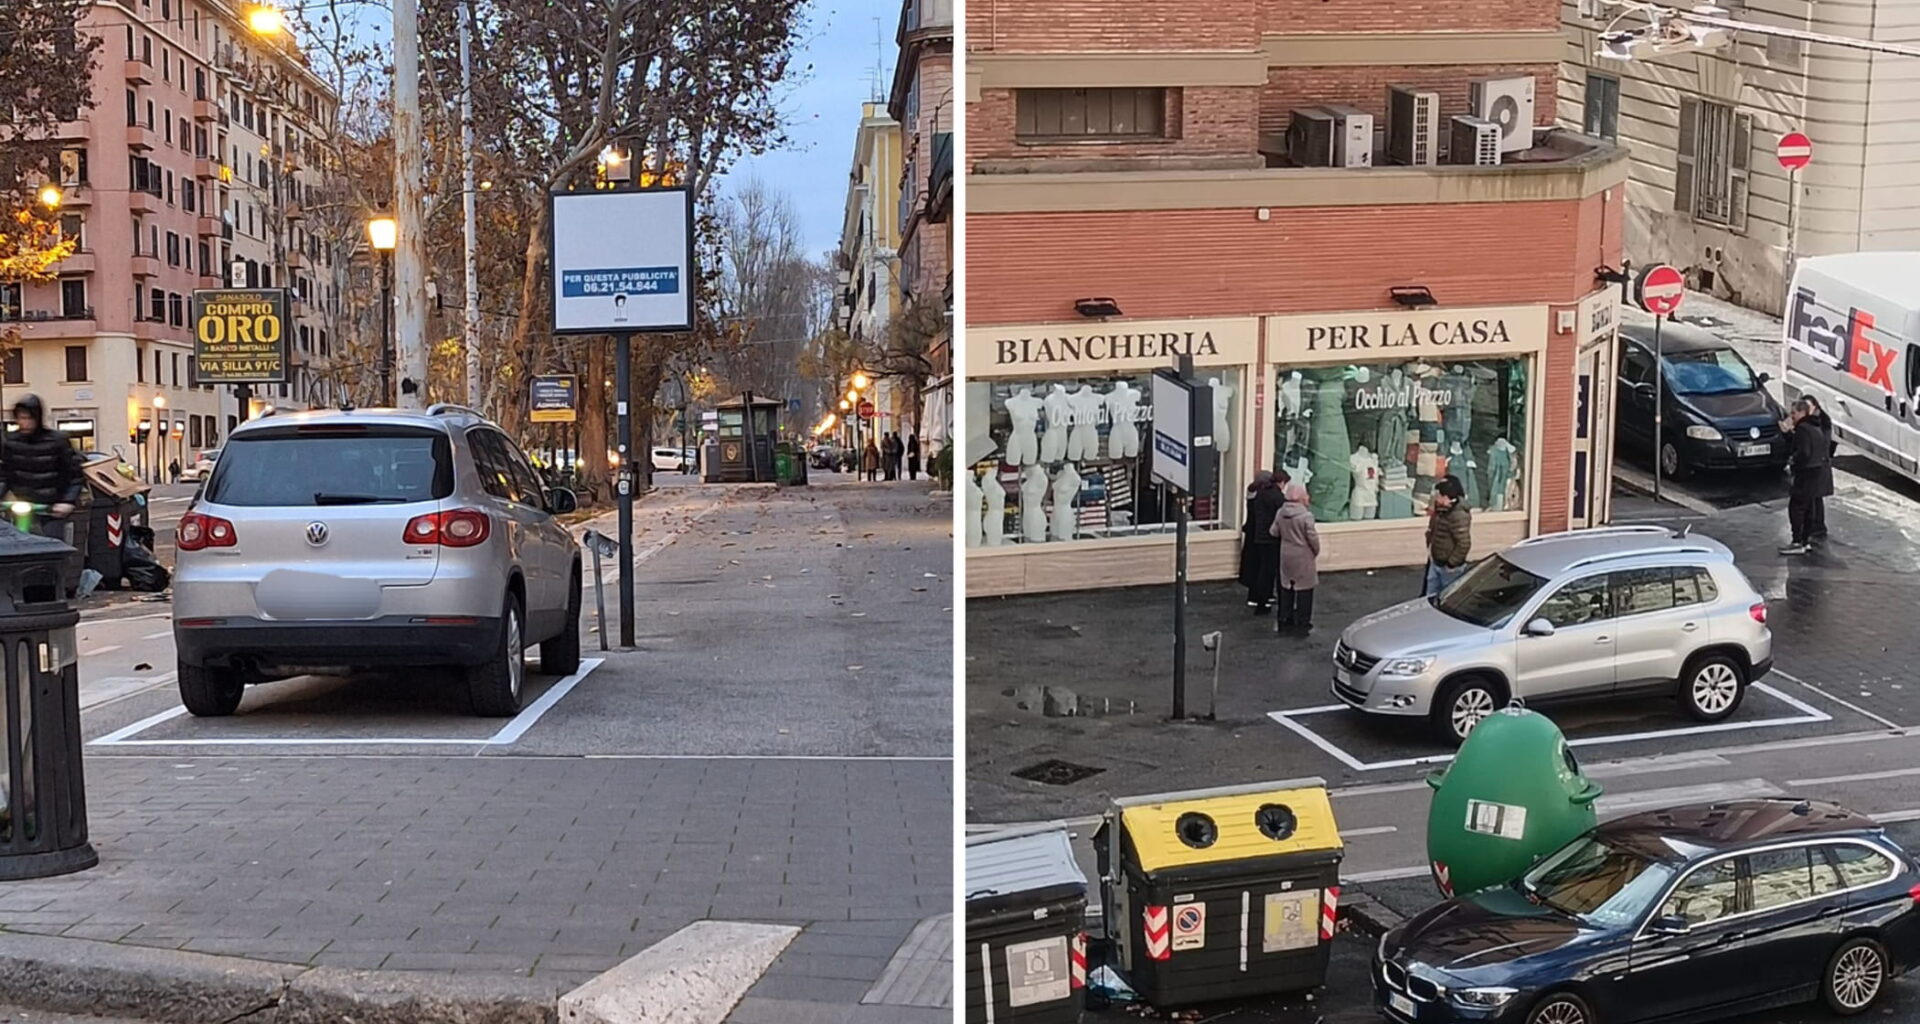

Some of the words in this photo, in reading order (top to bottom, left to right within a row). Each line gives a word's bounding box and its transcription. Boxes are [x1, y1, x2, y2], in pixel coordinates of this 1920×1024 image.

[564, 275, 582, 283] PER
[583, 273, 620, 282] QUESTA
[206, 303, 272, 315] COMPRO
[199, 315, 280, 343] ORO
[1306, 325, 1371, 351] PER
[1379, 322, 1421, 348] LA
[1429, 319, 1511, 345] CASA
[995, 331, 1219, 365] BIANCHERIA
[199, 361, 219, 371] VIA
[222, 361, 253, 371] SILLA
[255, 360, 280, 371] 91/C
[1355, 386, 1396, 410] Occhio
[1397, 385, 1410, 408] al
[1412, 384, 1452, 407] Prezzo
[1052, 403, 1095, 426] Occhio
[1098, 403, 1110, 425] al
